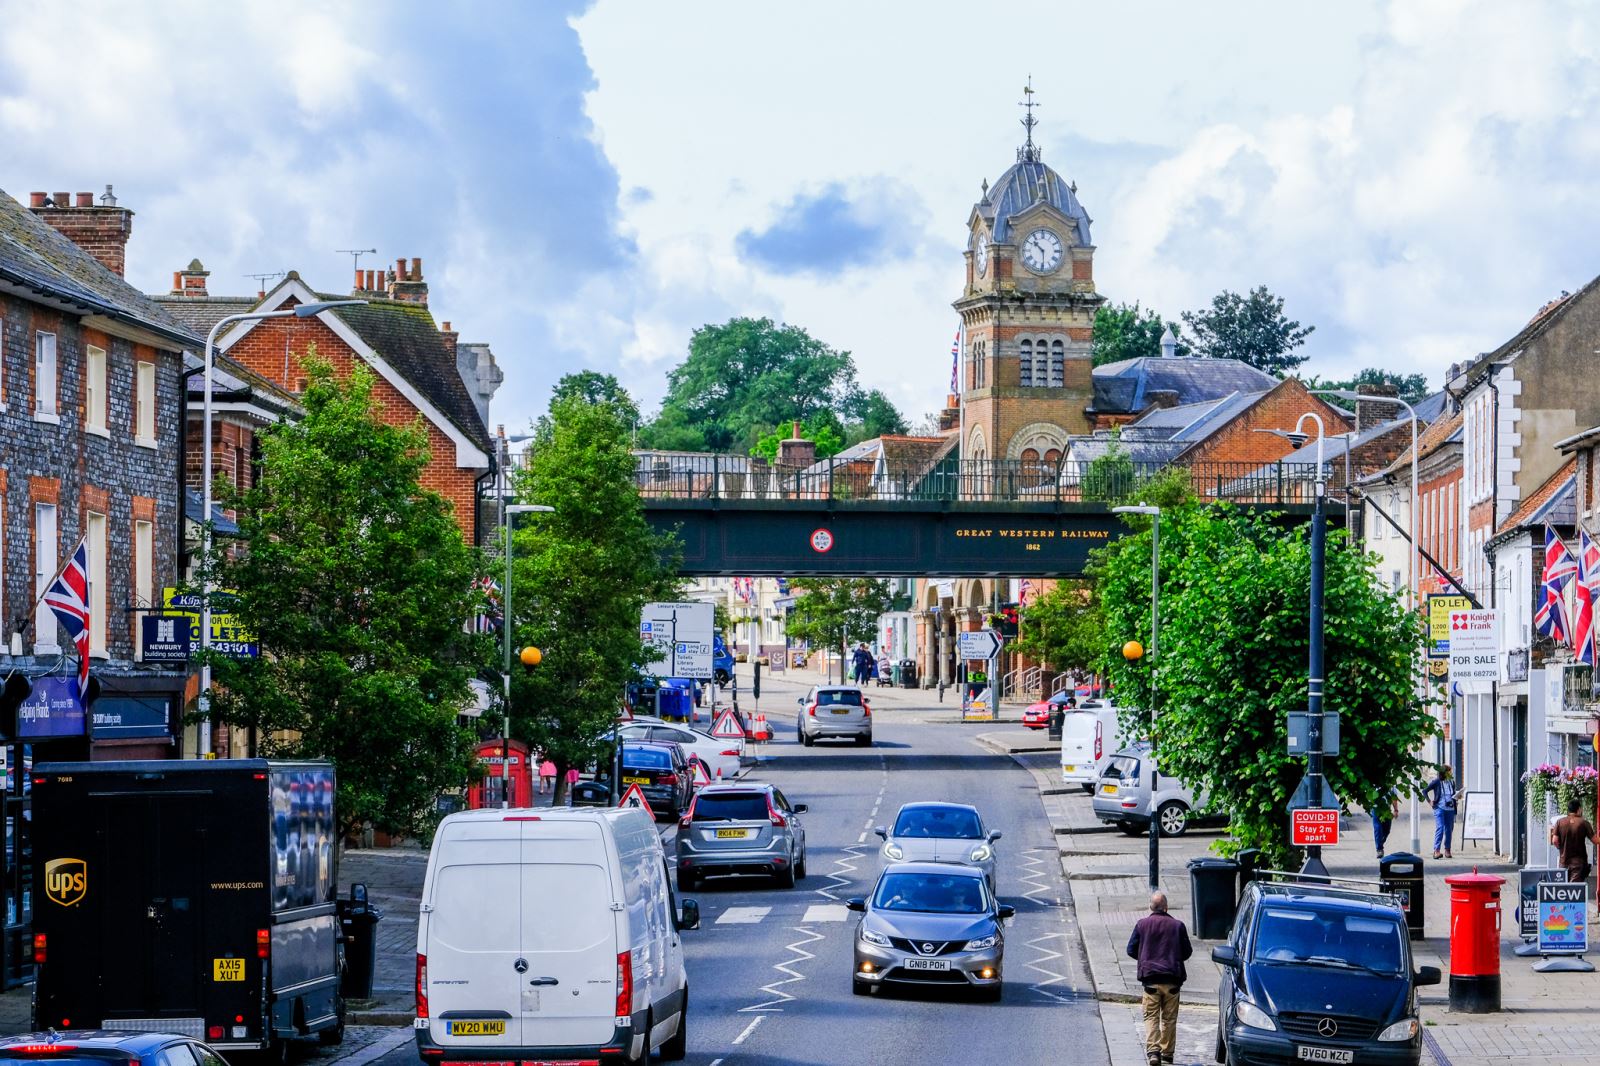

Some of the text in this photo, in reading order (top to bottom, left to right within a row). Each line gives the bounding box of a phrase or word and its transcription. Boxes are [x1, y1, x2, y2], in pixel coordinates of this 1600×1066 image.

[956, 529, 1109, 538] GREAT WESTERN RAILWAY
[1025, 543, 1041, 551] 1862
[1433, 599, 1466, 607] TO LET
[1470, 613, 1495, 622] Knight
[1470, 622, 1492, 630] Frank
[1453, 656, 1497, 665] FOR SALE
[36, 701, 50, 718] Hands
[1296, 813, 1335, 821] COVID-19
[1299, 825, 1317, 834] Stay
[1305, 834, 1327, 843] apart
[49, 872, 84, 899] ups
[210, 882, 264, 891] www.ups.com
[1543, 886, 1582, 901] New
[219, 960, 241, 970] AX15
[909, 960, 946, 969] GN18 POH
[220, 970, 240, 980] XUT
[453, 1022, 480, 1033] WV20
[1302, 1047, 1328, 1060] BV60
